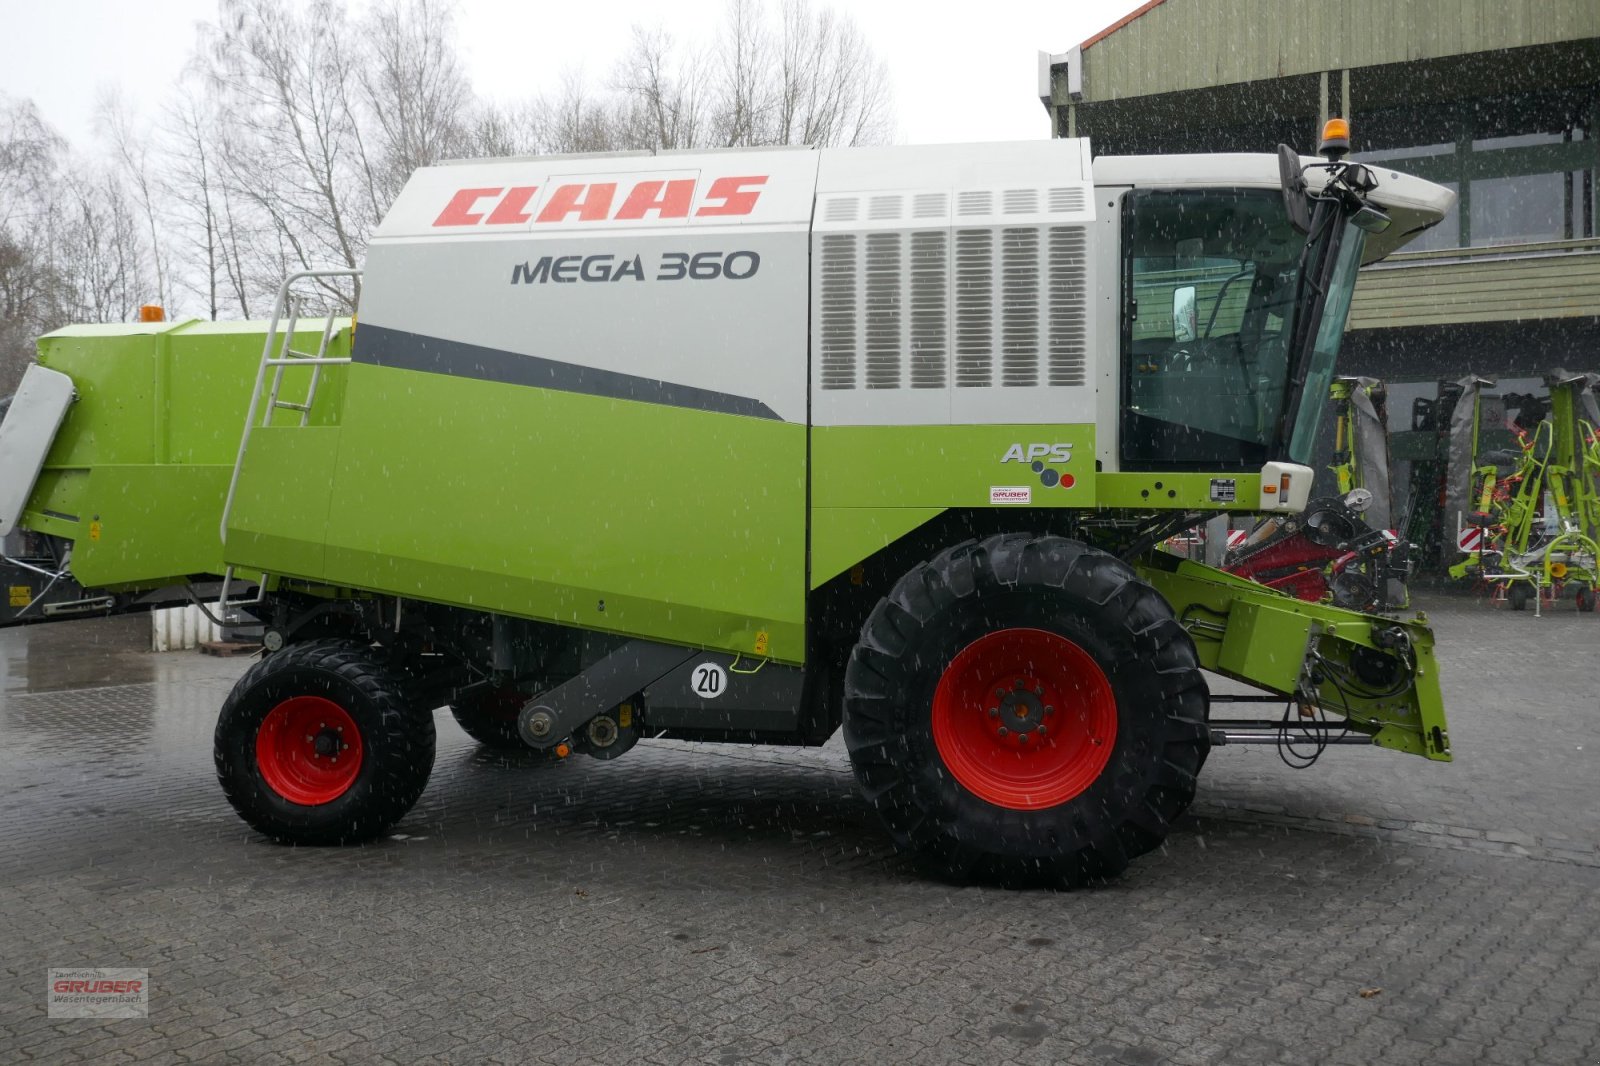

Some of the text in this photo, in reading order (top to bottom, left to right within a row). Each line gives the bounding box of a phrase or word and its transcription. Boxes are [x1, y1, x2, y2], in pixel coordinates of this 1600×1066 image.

[432, 175, 770, 227] CLAAS
[510, 250, 761, 285] MEGA 360
[1000, 443, 1073, 463] APS
[697, 668, 720, 693] 20
